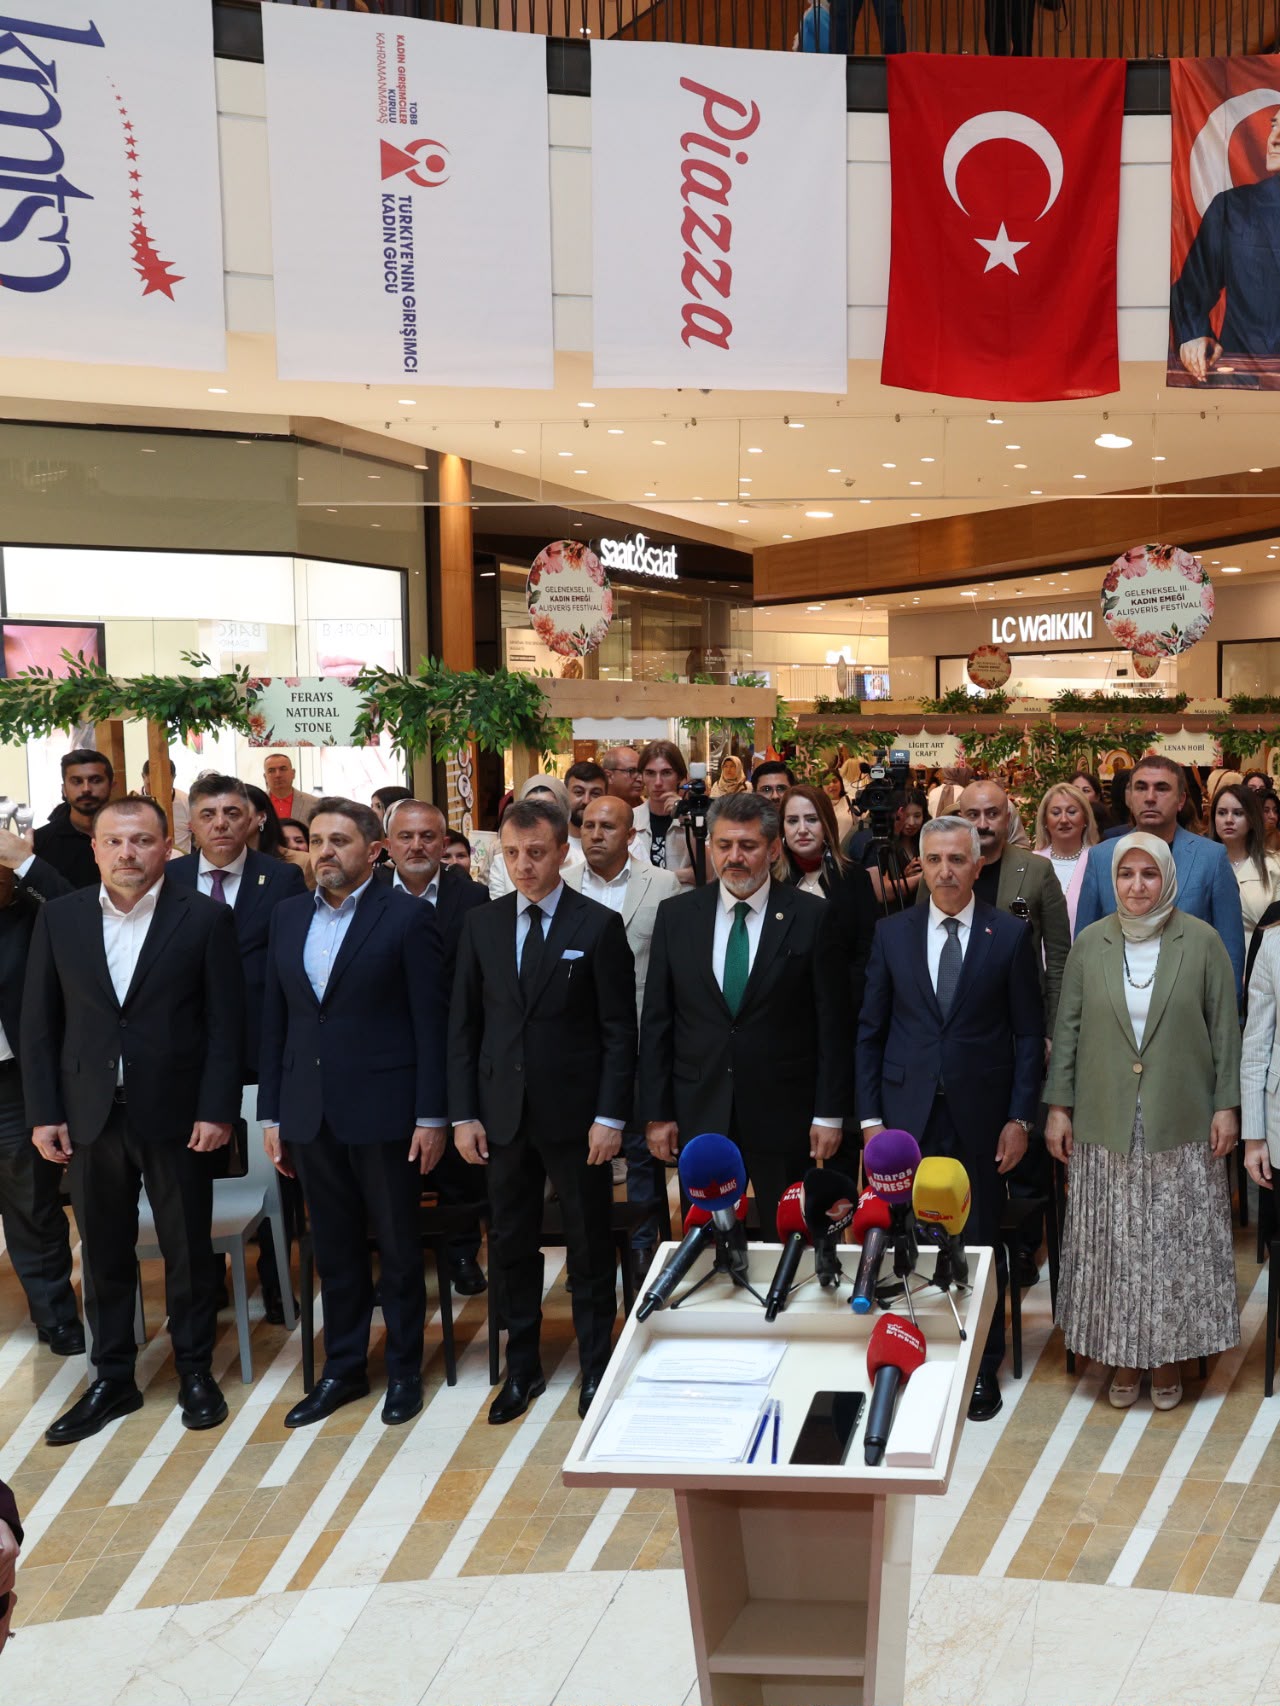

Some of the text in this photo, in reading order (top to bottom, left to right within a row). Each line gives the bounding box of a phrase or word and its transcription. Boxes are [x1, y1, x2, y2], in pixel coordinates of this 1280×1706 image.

[396, 34, 406, 64] KADIN
[376, 32, 388, 124] KAHRAMANMARAŞ
[388, 88, 397, 124] KURULU
[409, 102, 418, 125] TOBB
[679, 77, 761, 350] Piazza
[381, 193, 398, 294] KADIN GÜCÜ
[600, 533, 679, 579] saat&saat
[571, 594, 591, 602] EMEĞİ
[1124, 586, 1178, 598] GELENEKSEL
[1131, 593, 1185, 606] KADIN EMEĞİ
[1160, 601, 1202, 611] FESTİVALİ
[992, 616, 1016, 643] LC
[291, 692, 333, 703] FERAYS
[286, 707, 340, 718] NATURAL
[294, 722, 332, 733] STONE
[908, 741, 929, 749] LİGHT
[1187, 743, 1205, 751] HOBİ
